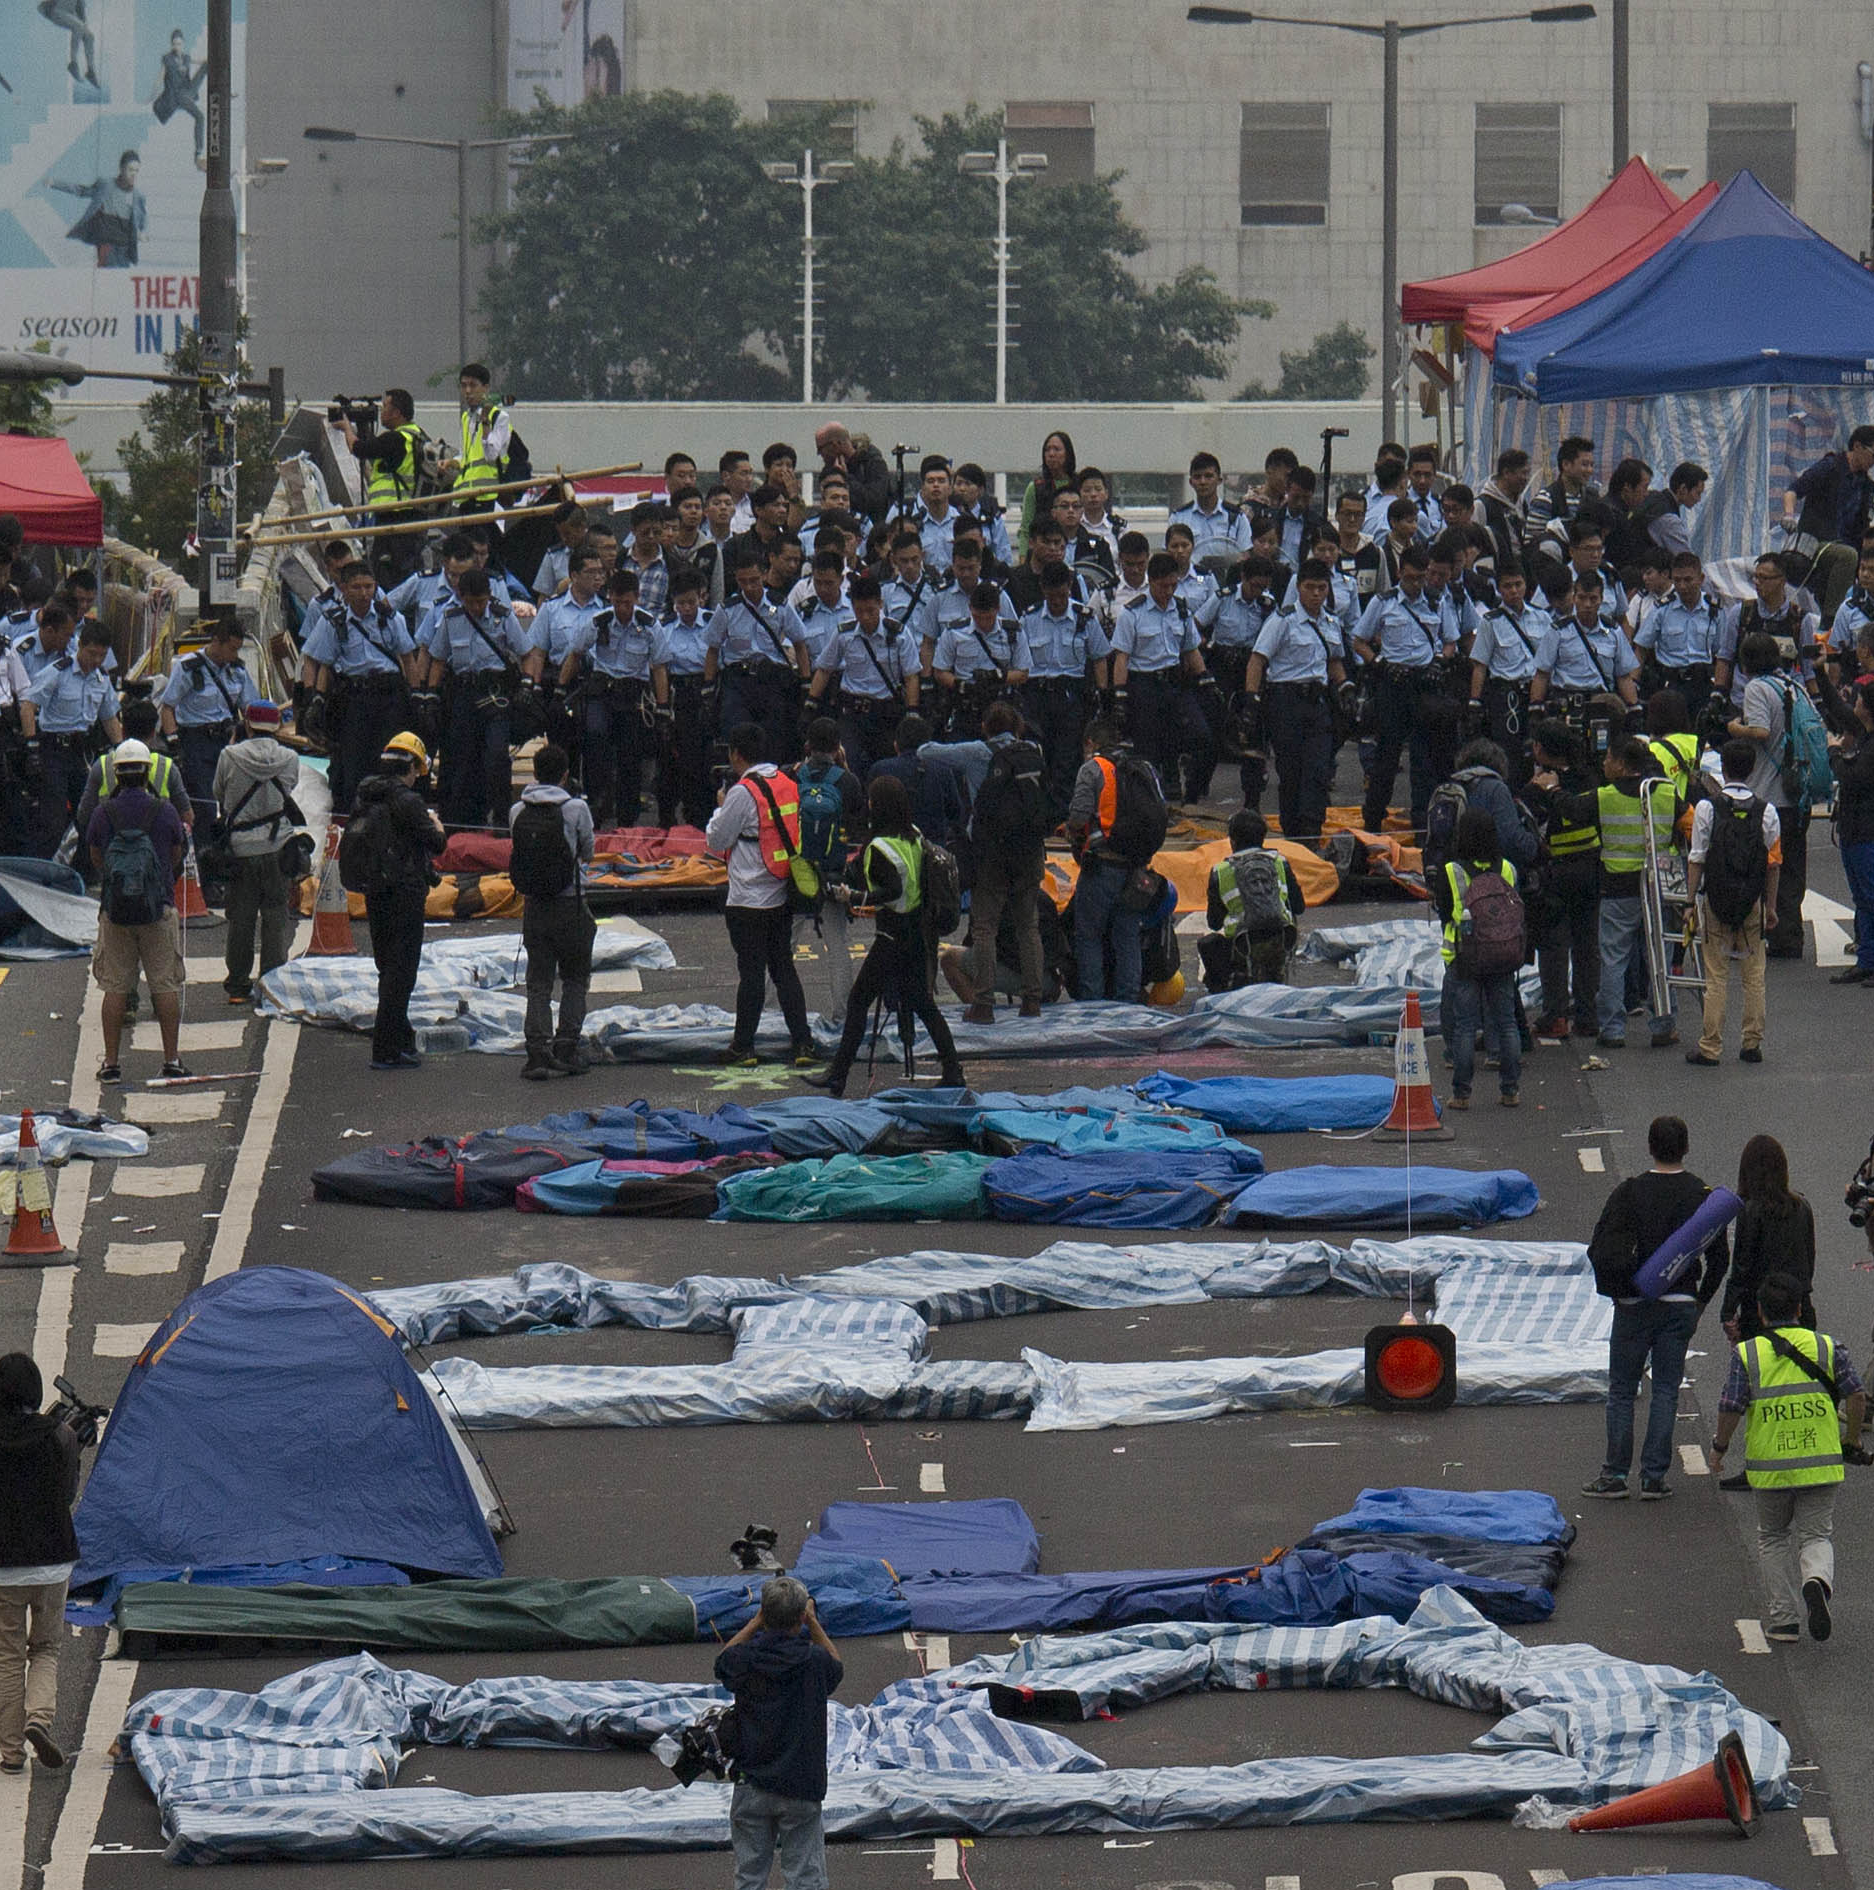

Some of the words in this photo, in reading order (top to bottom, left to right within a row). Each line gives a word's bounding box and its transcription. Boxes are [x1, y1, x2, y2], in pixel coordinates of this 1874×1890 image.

[130, 275, 201, 310] THEAT
[19, 316, 119, 338] season
[135, 313, 163, 354] IN
[1761, 1399, 1827, 1423] PRESS
[1776, 1427, 1818, 1452] 記者
